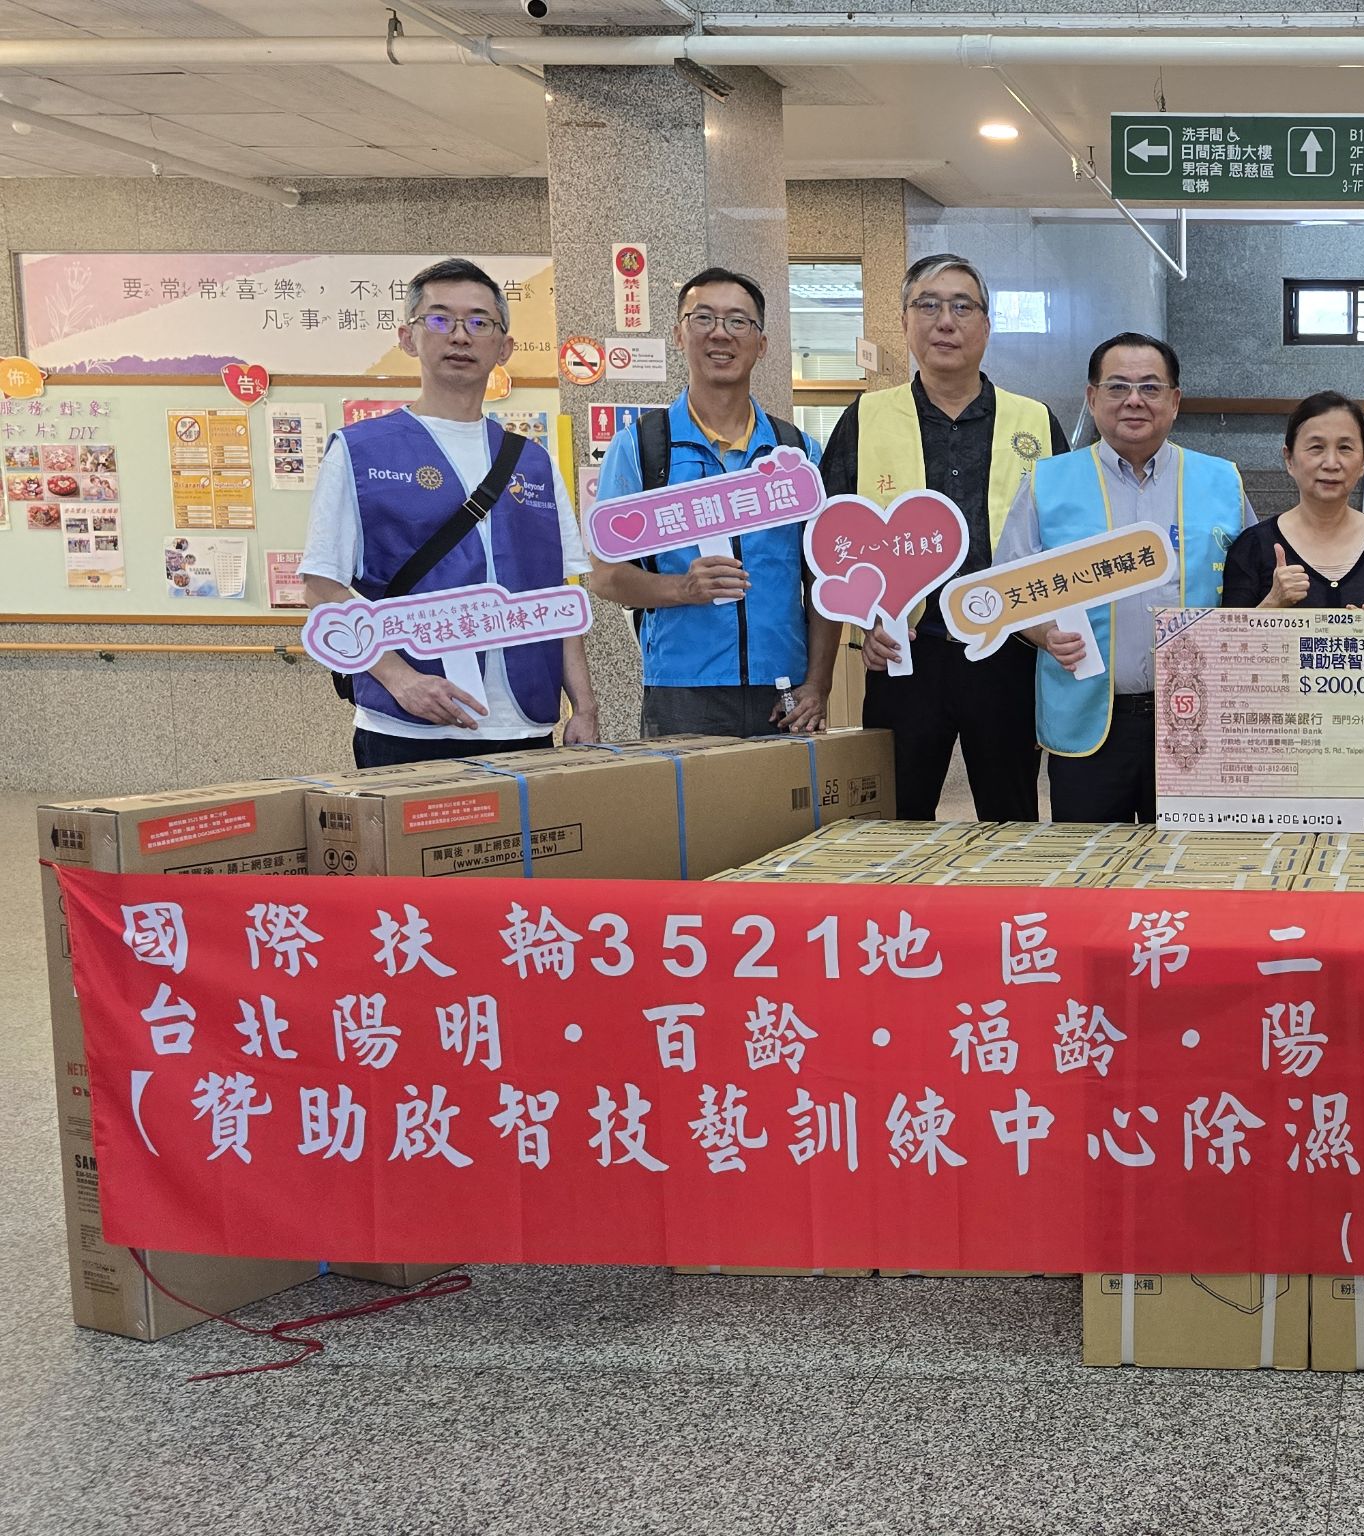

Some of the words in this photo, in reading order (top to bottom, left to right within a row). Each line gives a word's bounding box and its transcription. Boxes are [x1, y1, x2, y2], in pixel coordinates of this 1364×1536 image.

[1182, 128, 1223, 142] 洗手間
[1350, 129, 1364, 141] B1
[1181, 144, 1273, 160] 日間活動大樓
[1350, 145, 1364, 158] 2F
[1182, 162, 1223, 177] 男宿舍
[1228, 163, 1275, 179] 恩慈區
[1350, 163, 1364, 176] 7F
[1182, 179, 1210, 194] 電梯
[1342, 180, 1364, 193] 3-7F
[623, 278, 642, 328] 禁止攝影
[6, 368, 28, 387] 佈
[237, 376, 258, 394] 告
[68, 426, 98, 440] DIY
[368, 468, 413, 483] Rotary
[876, 474, 896, 494] 社
[653, 478, 799, 537] 感謝有您
[833, 530, 944, 565] 愛心捐贈
[1004, 545, 1157, 610] 支持身心障礙者
[382, 602, 575, 645] 啟智技藝訓練中心
[1249, 619, 1311, 629] CA6070631
[1328, 614, 1354, 624] 2025
[1220, 712, 1323, 726] 台新國際商業銀行
[1221, 727, 1249, 735] Taishin
[1251, 727, 1300, 735] International
[1302, 727, 1323, 735] Bank
[825, 779, 839, 795] 55
[818, 794, 839, 806] ED
[453, 843, 557, 871] (www.sampo.cm.tw)
[1109, 1279, 1154, 1291] 粉水箱
